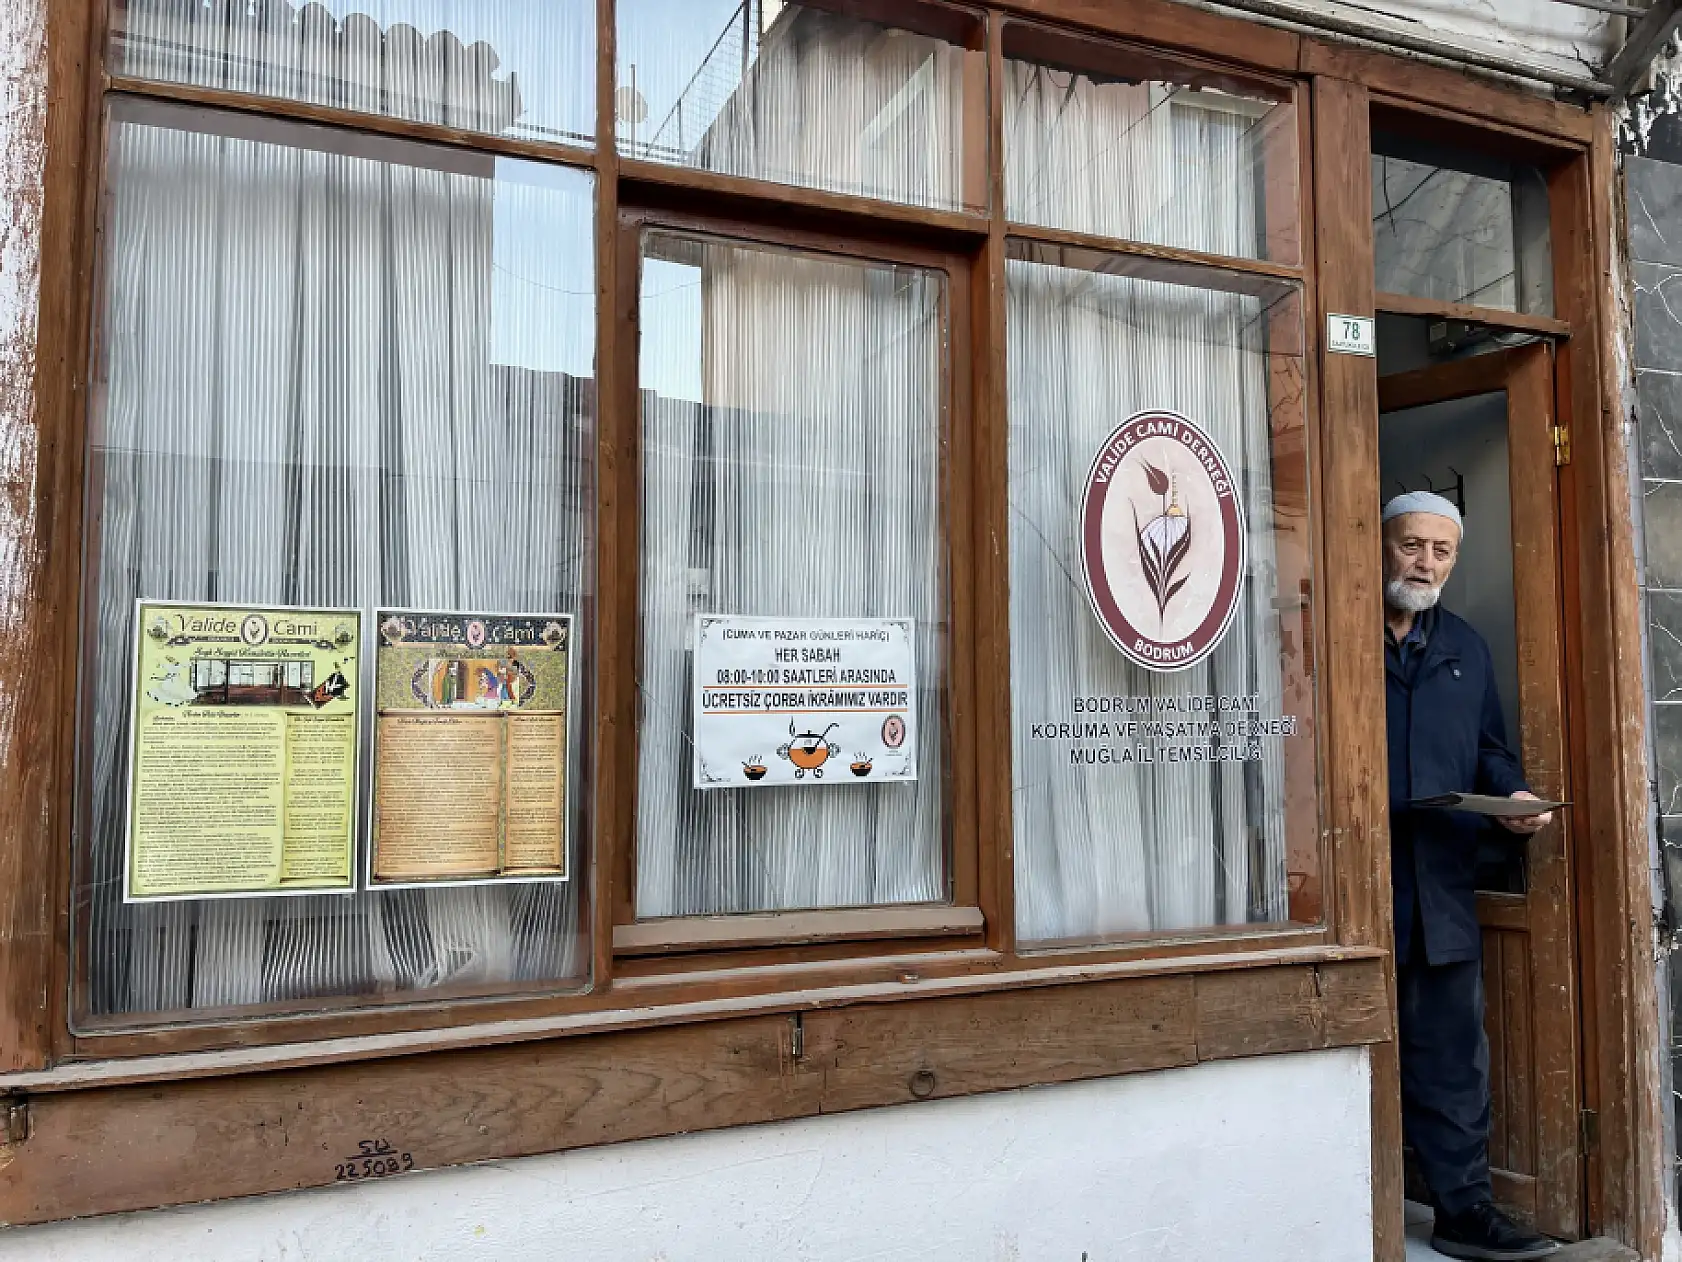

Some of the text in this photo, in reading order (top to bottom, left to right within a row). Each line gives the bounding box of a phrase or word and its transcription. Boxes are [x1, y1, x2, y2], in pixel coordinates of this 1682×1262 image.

[1342, 321, 1361, 341] 78
[172, 613, 318, 636] Valide Cami
[757, 630, 772, 640] VE
[774, 630, 807, 641] PAZAR
[809, 629, 855, 641] GÜNLERİ
[774, 647, 840, 663] HER SABAH
[1134, 638, 1195, 660] BODRUM
[717, 666, 897, 684] 08:00-10:00 SAATLERİ ARASINDA
[702, 689, 761, 708] ÜCRETSİZ
[764, 692, 805, 712] ÇORBA
[868, 691, 908, 707] VARDIR
[1073, 696, 1151, 713] BODRUM
[1154, 692, 1216, 713] VALİDE
[1030, 722, 1111, 739] KORUMA
[1114, 721, 1138, 737] VE
[1141, 720, 1221, 741] YAŞATMA
[1069, 744, 1133, 765] MUĞLA
[1137, 743, 1153, 763] İL
